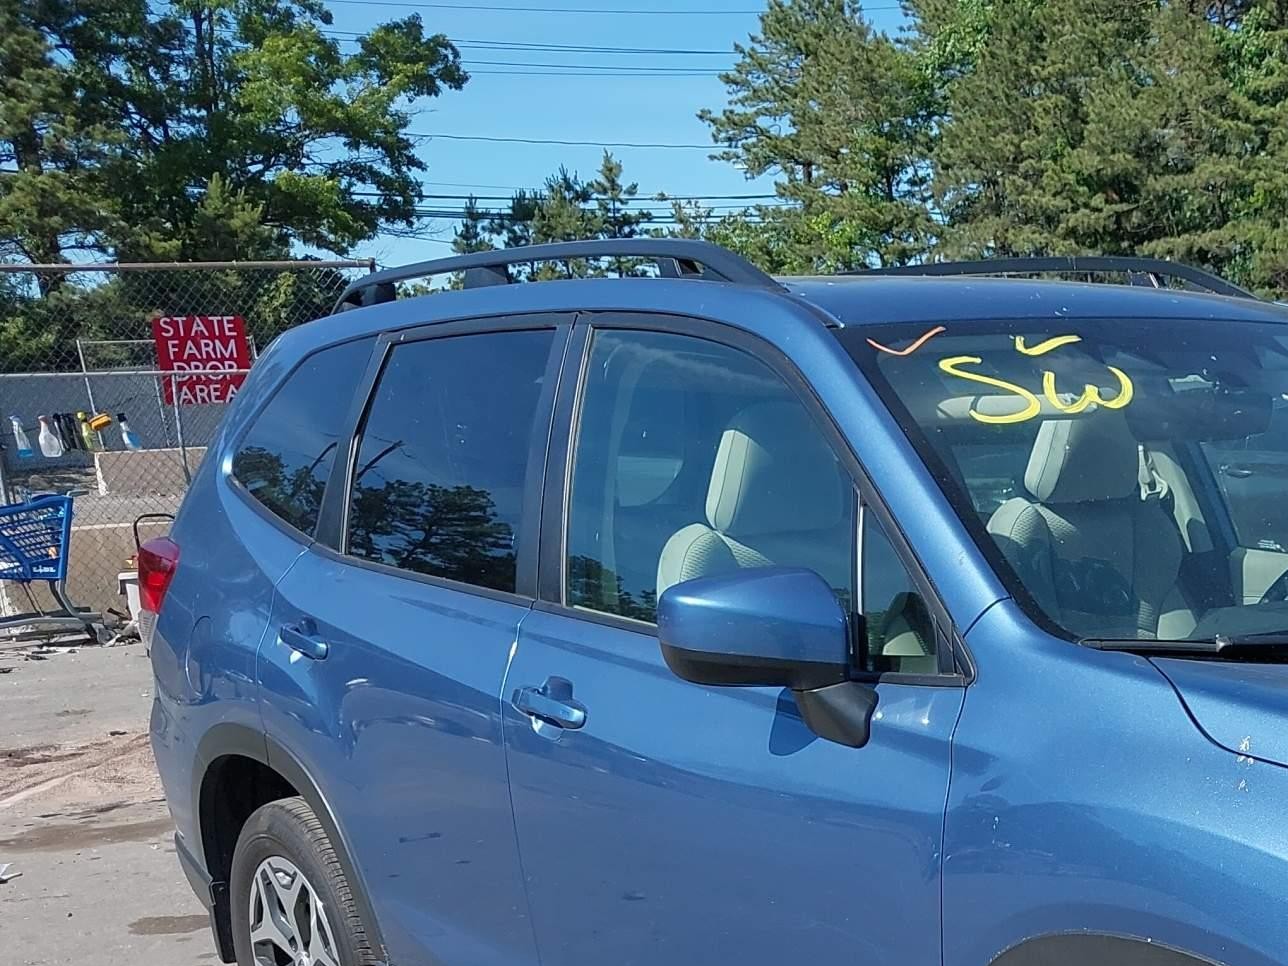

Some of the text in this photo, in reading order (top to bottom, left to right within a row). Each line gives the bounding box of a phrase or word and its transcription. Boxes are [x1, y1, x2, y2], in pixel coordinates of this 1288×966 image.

[159, 315, 238, 337] STATE
[167, 339, 238, 360] FARM
[173, 360, 238, 382] DROP
[179, 383, 240, 404] AREA
